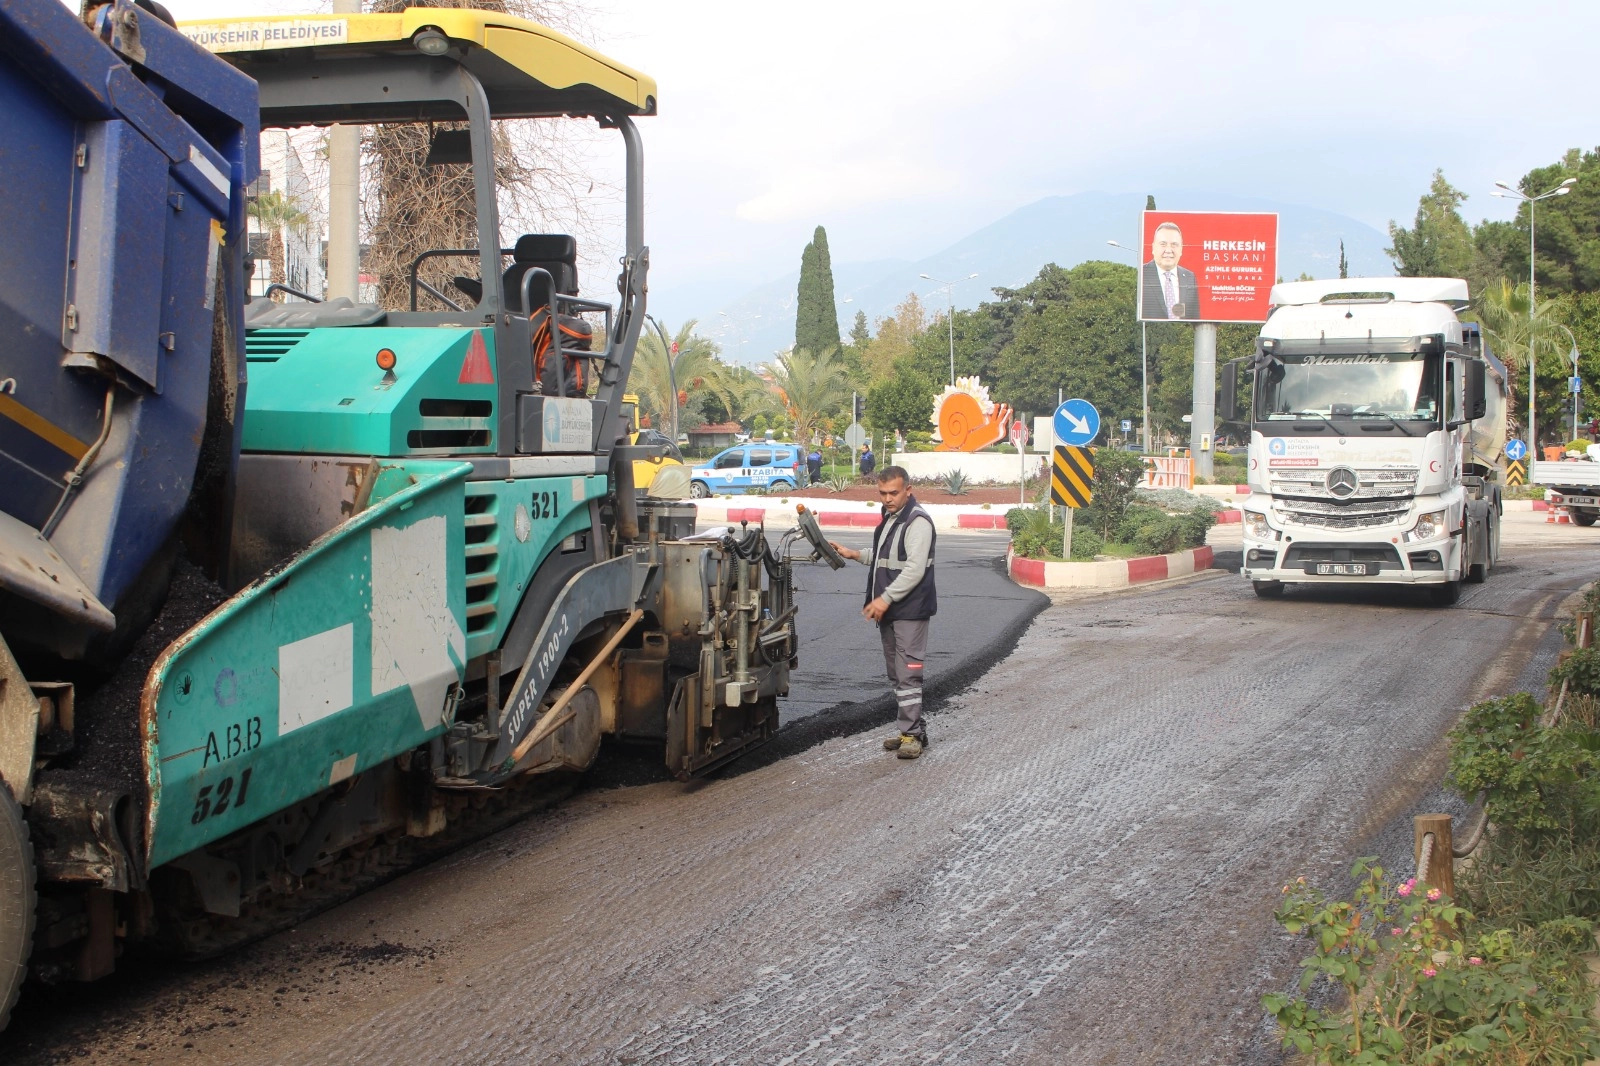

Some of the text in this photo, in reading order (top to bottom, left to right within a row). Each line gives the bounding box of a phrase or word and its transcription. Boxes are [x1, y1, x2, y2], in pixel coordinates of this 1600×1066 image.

[264, 22, 342, 41] BELEDİYESİ
[1203, 239, 1266, 251] HERKESİN
[1203, 253, 1266, 262] BAŞKANI
[532, 491, 559, 520] 521
[1321, 565, 1330, 573] 07
[1353, 565, 1363, 574] 52
[508, 613, 569, 744] SUPER 1900-2
[203, 716, 262, 769] A.B.B
[191, 767, 253, 826] 521
